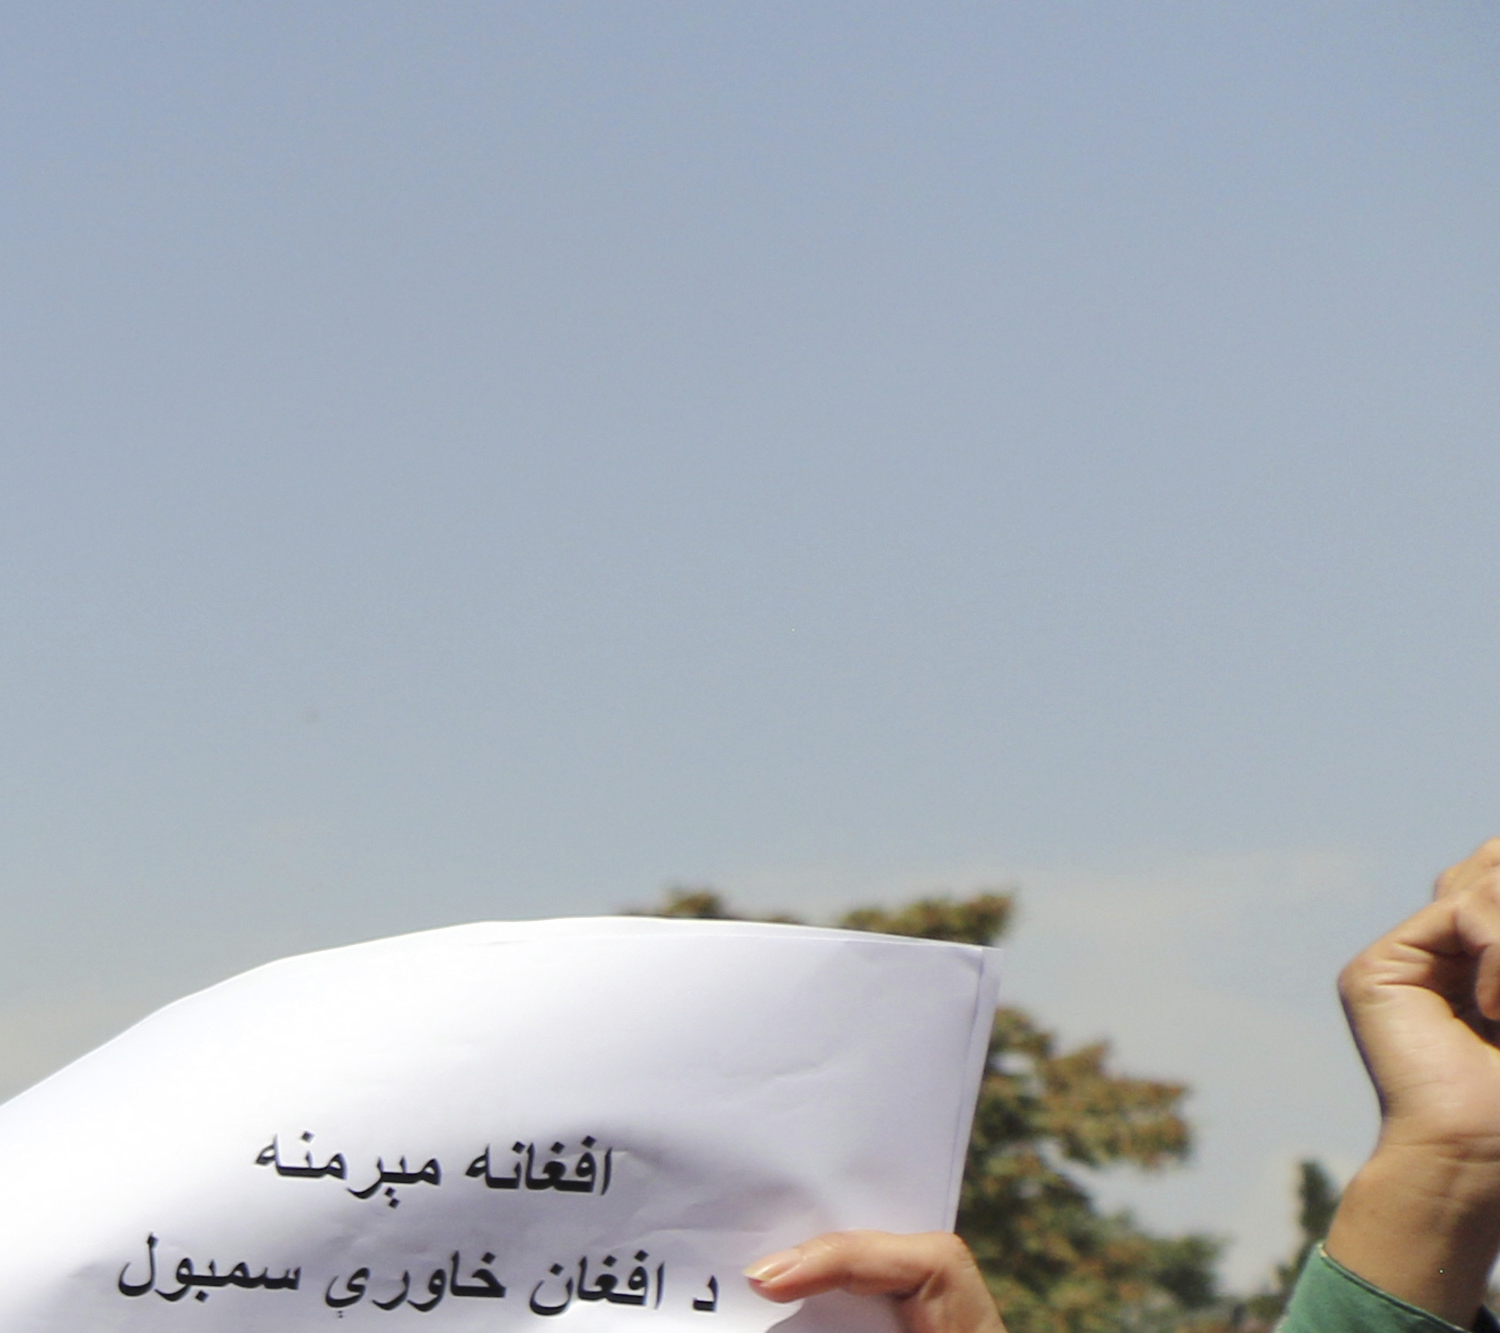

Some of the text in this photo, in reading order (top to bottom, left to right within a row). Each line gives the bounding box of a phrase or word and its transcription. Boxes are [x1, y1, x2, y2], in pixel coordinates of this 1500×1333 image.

[465, 1136, 612, 1195] افغانه
[118, 1235, 301, 1302] سمبول
[529, 1250, 664, 1316] افغان
[693, 1275, 718, 1312] د
